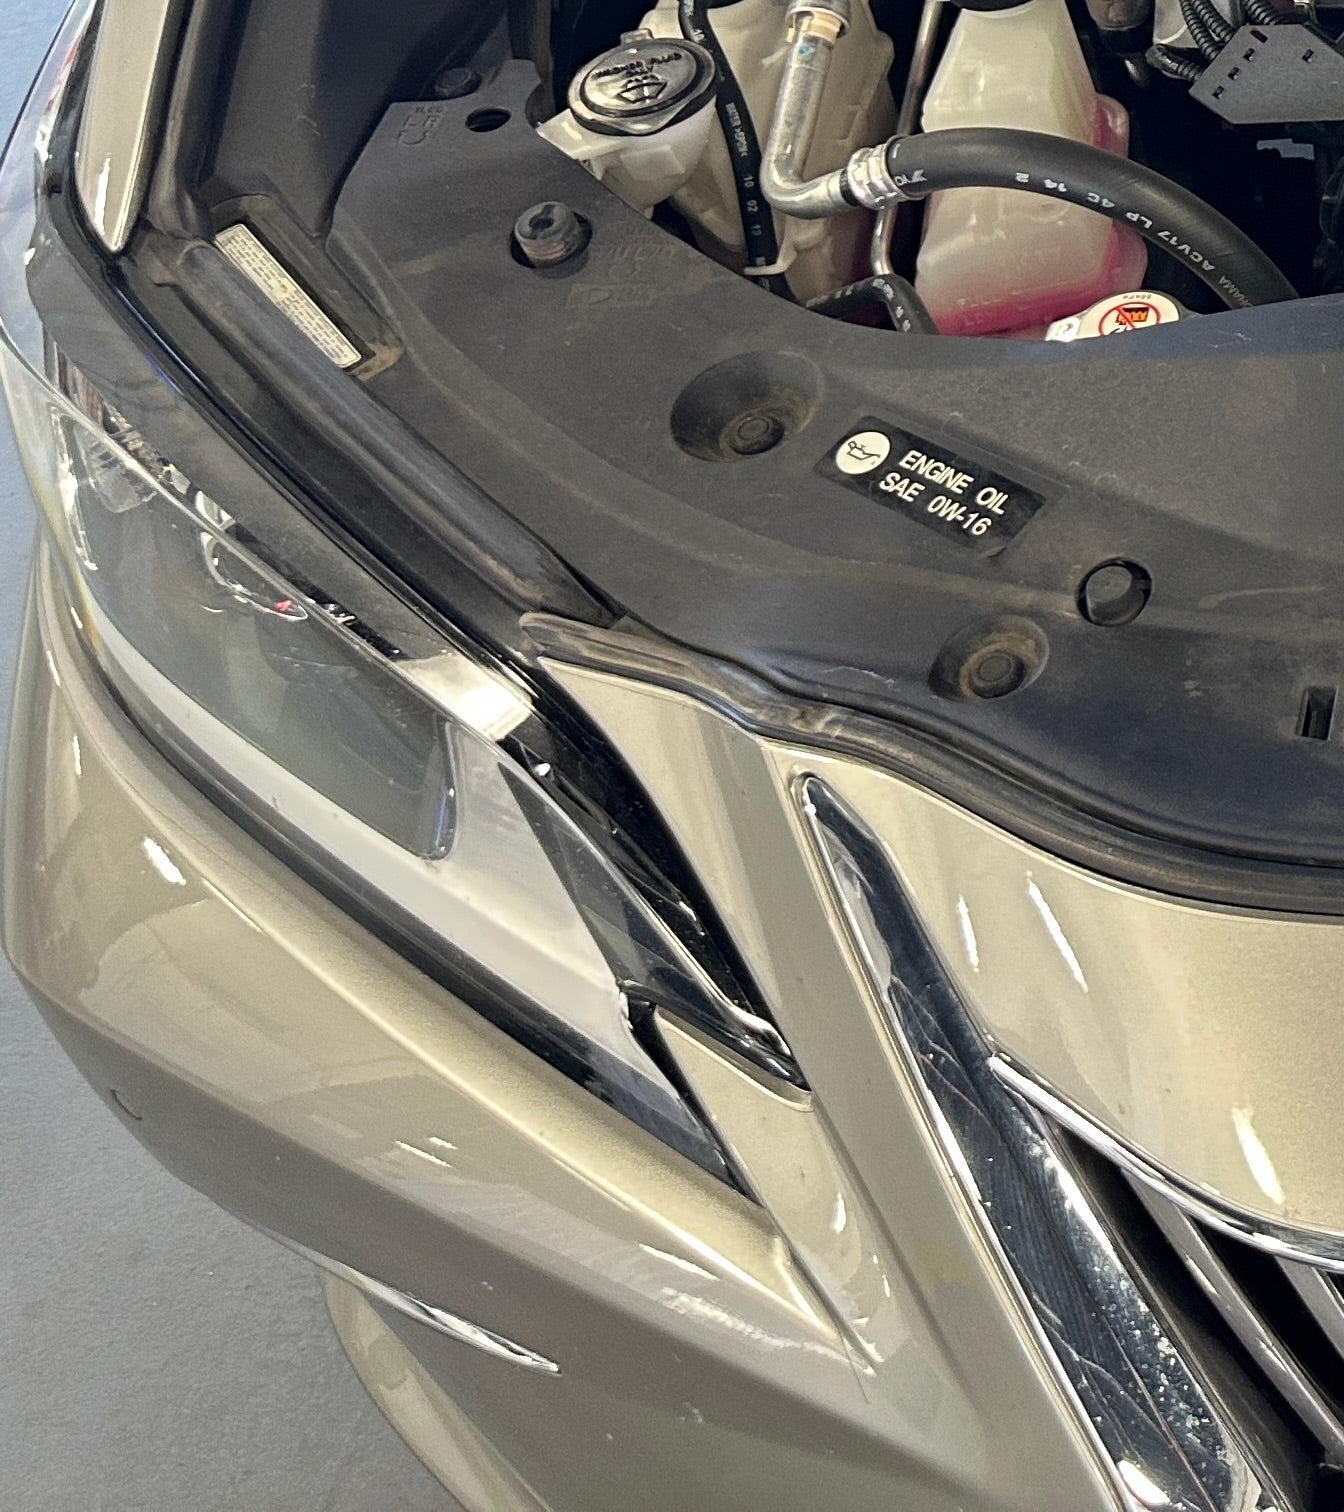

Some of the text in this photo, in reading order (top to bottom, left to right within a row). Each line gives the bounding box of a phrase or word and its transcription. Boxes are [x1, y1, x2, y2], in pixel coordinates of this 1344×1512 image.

[1086, 191, 1116, 209] 4C
[1125, 211, 1154, 229] LP
[1157, 229, 1216, 272] ACV17
[898, 449, 1009, 515] ENGINE OIL
[879, 472, 992, 536] SAE 0W-16
